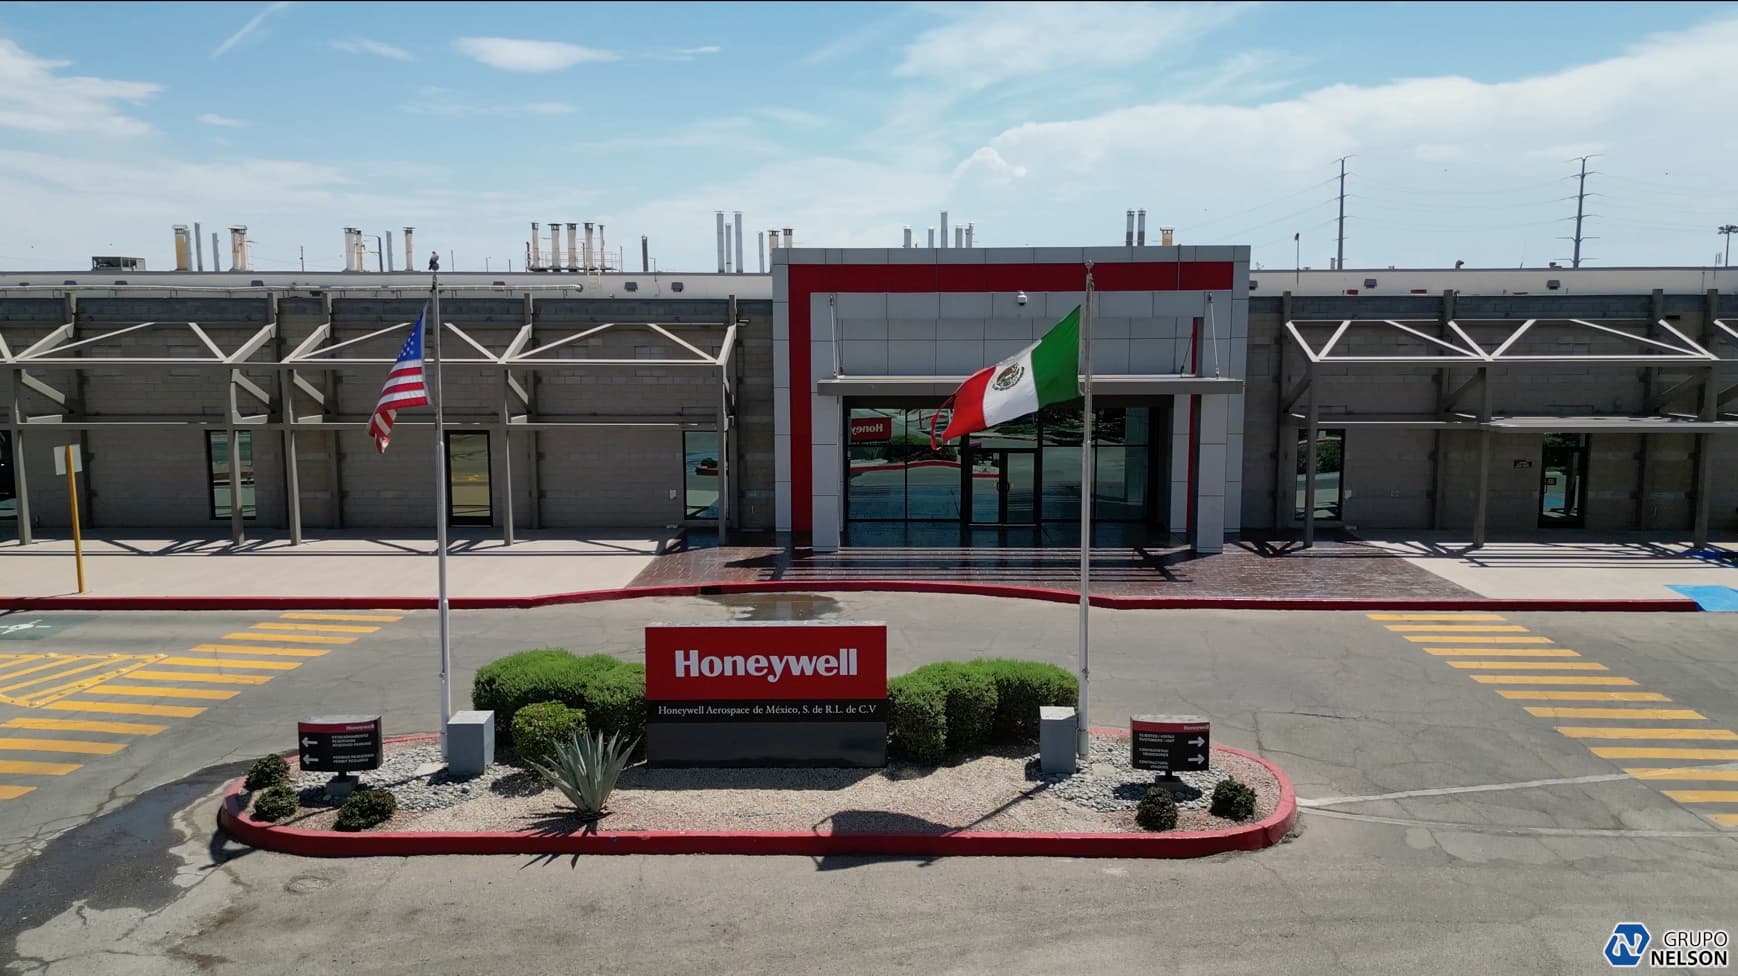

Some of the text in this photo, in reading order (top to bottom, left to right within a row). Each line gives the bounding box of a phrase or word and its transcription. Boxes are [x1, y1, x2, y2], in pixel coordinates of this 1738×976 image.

[674, 648, 858, 683] Honeywell
[658, 704, 877, 717] Honeywell Aerospace de México, S. de R.L. de C.V
